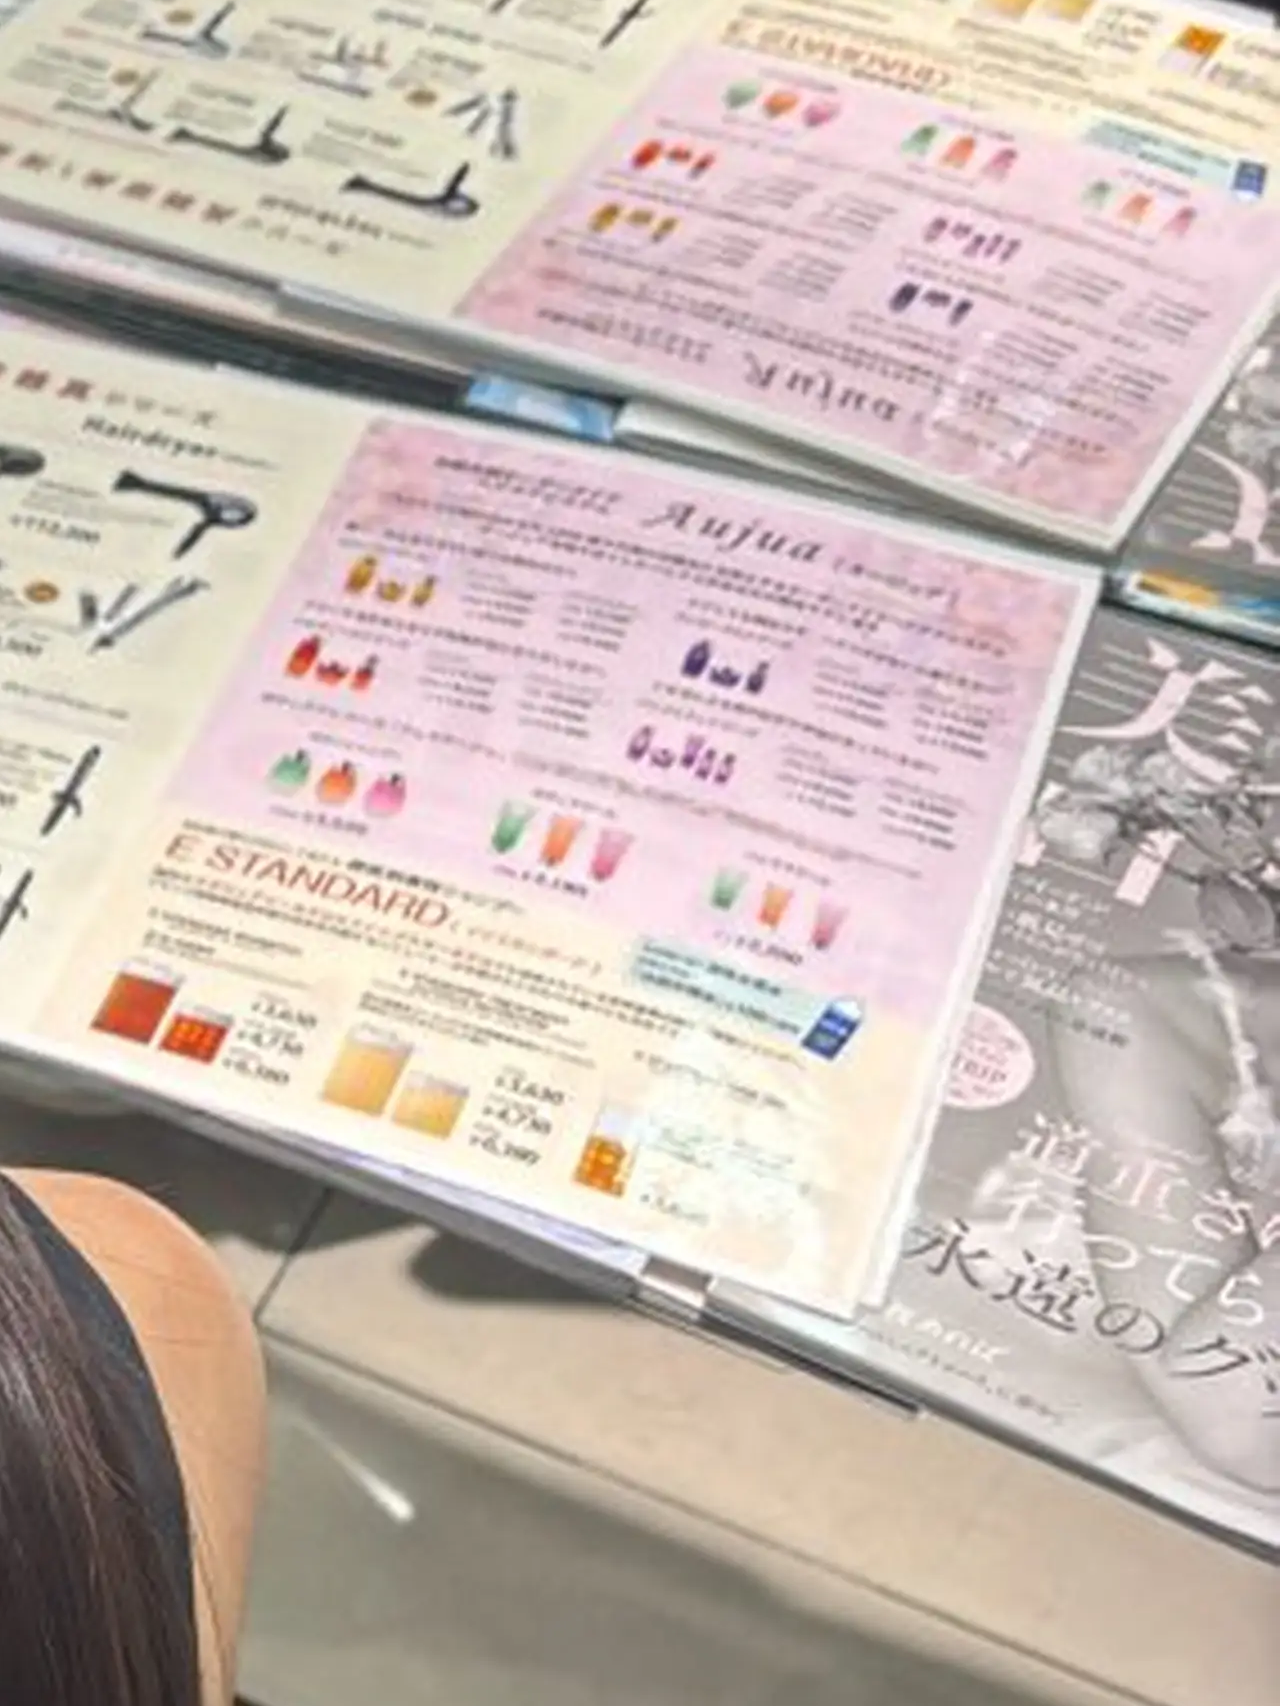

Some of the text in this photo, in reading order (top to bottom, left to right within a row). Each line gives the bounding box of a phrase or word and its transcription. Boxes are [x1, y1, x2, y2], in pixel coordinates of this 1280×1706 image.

[641, 501, 822, 562] Aujua
[204, 844, 450, 929] STANDARD
[903, 1218, 1280, 1394] 永遠のグ
